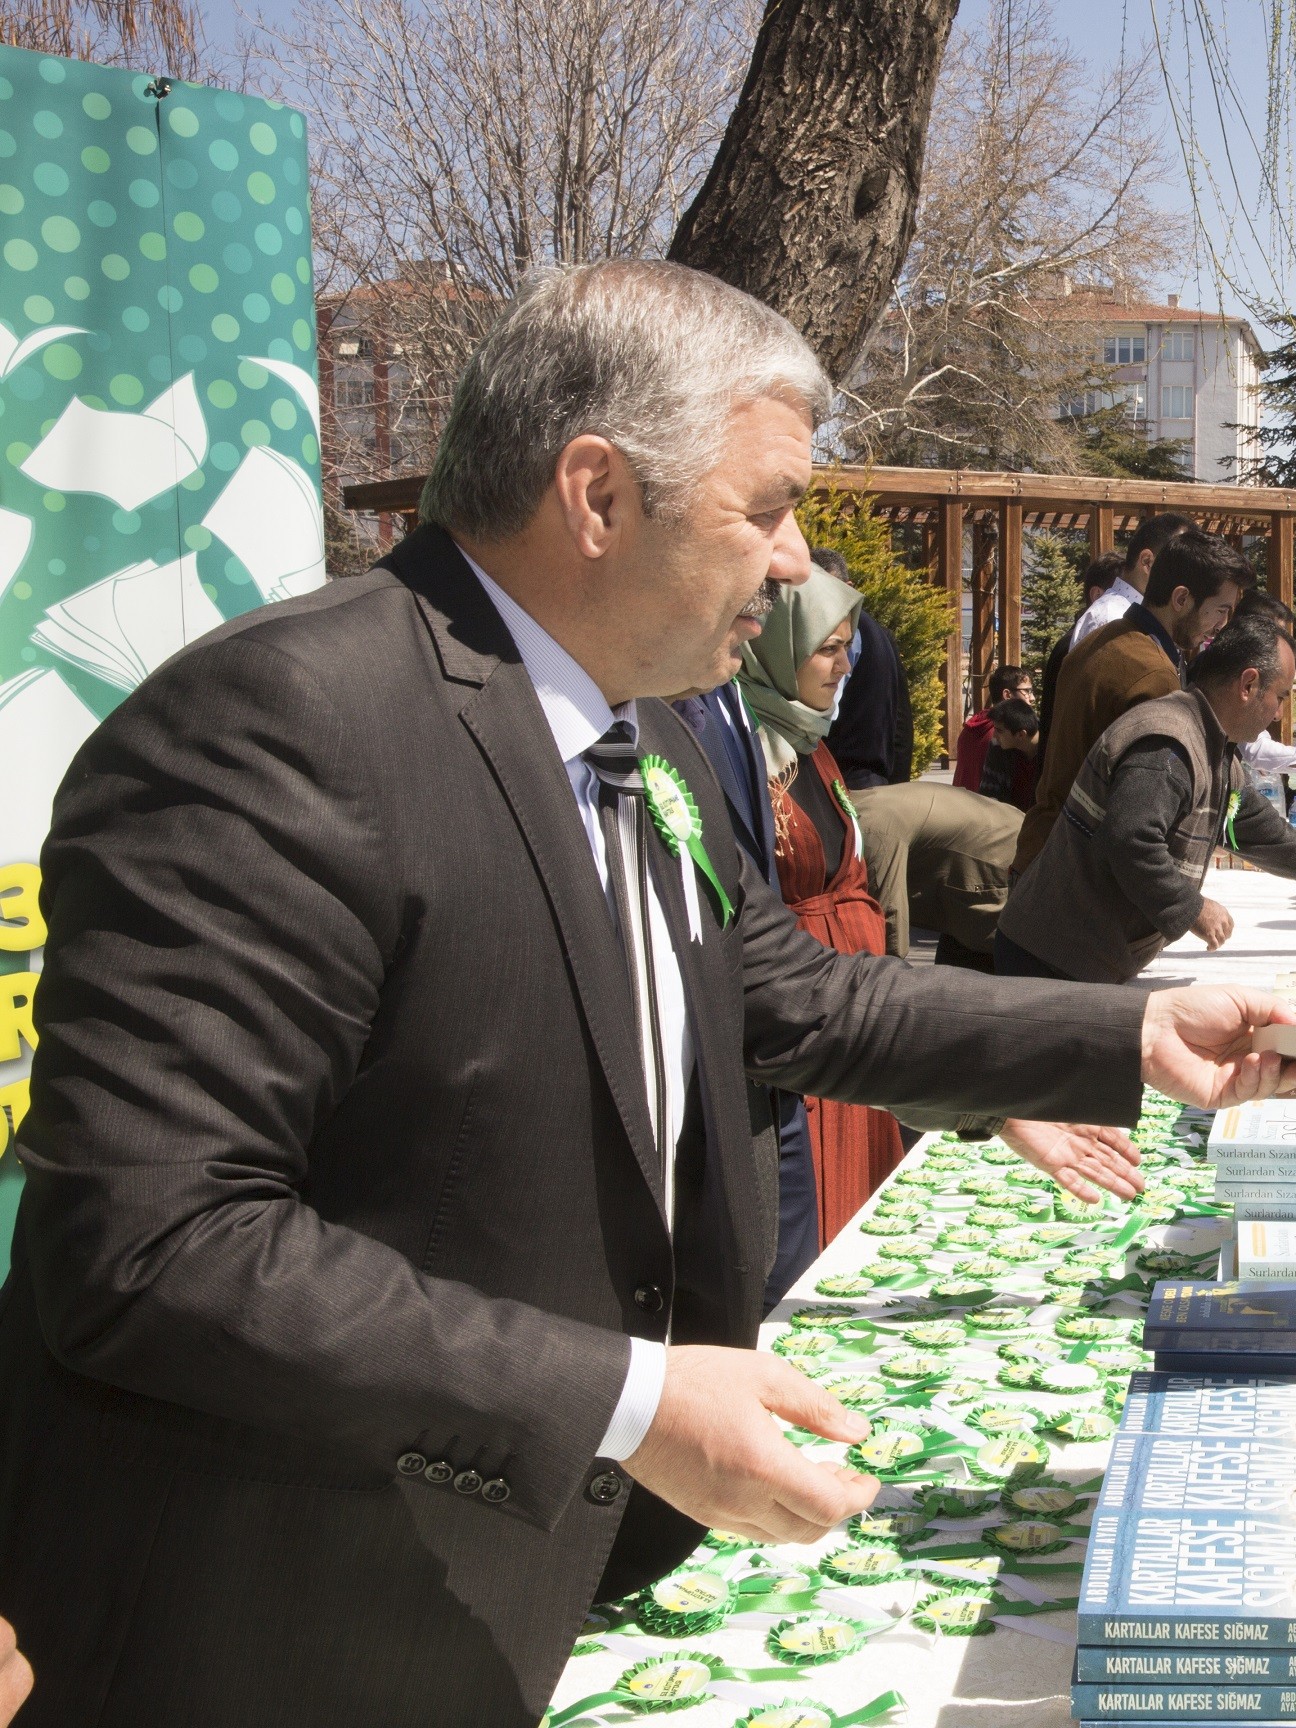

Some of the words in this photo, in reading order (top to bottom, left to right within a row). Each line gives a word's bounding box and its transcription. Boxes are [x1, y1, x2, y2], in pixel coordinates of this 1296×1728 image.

[1217, 1148, 1266, 1159] Surlardan
[1269, 1149, 1296, 1160] Sızan
[1226, 1166, 1275, 1176] Surlardan
[1224, 1188, 1274, 1199] Surlardan
[1244, 1209, 1294, 1220] Surlardan
[1164, 1288, 1177, 1299] DELİ
[1132, 1376, 1152, 1395] AYATA
[1160, 1377, 1204, 1433] KARTALLAR
[1198, 1378, 1257, 1436] KAFESE
[1113, 1438, 1136, 1462] AYATA
[1141, 1440, 1193, 1509] KARTALLAR
[1183, 1441, 1250, 1510] KAFESE
[1102, 1467, 1130, 1507] ABDULLAH
[1097, 1516, 1120, 1545] AYATA
[1128, 1518, 1182, 1605] KARTALLAR
[1174, 1519, 1245, 1606] KAFESE
[1085, 1548, 1112, 1604] ABDULLAH
[1105, 1622, 1170, 1639] KARTALLAR
[1175, 1623, 1219, 1640] KAFESE
[1223, 1621, 1269, 1641] SIĞMAZ
[1106, 1657, 1171, 1675] KARTALLAR
[1176, 1658, 1221, 1675] KAFESE
[1224, 1656, 1270, 1675] SIĞMAZ
[1098, 1693, 1163, 1711] KARTALLAR
[1168, 1693, 1212, 1710] KAFESE
[1216, 1692, 1262, 1710] SIĞMAZ
